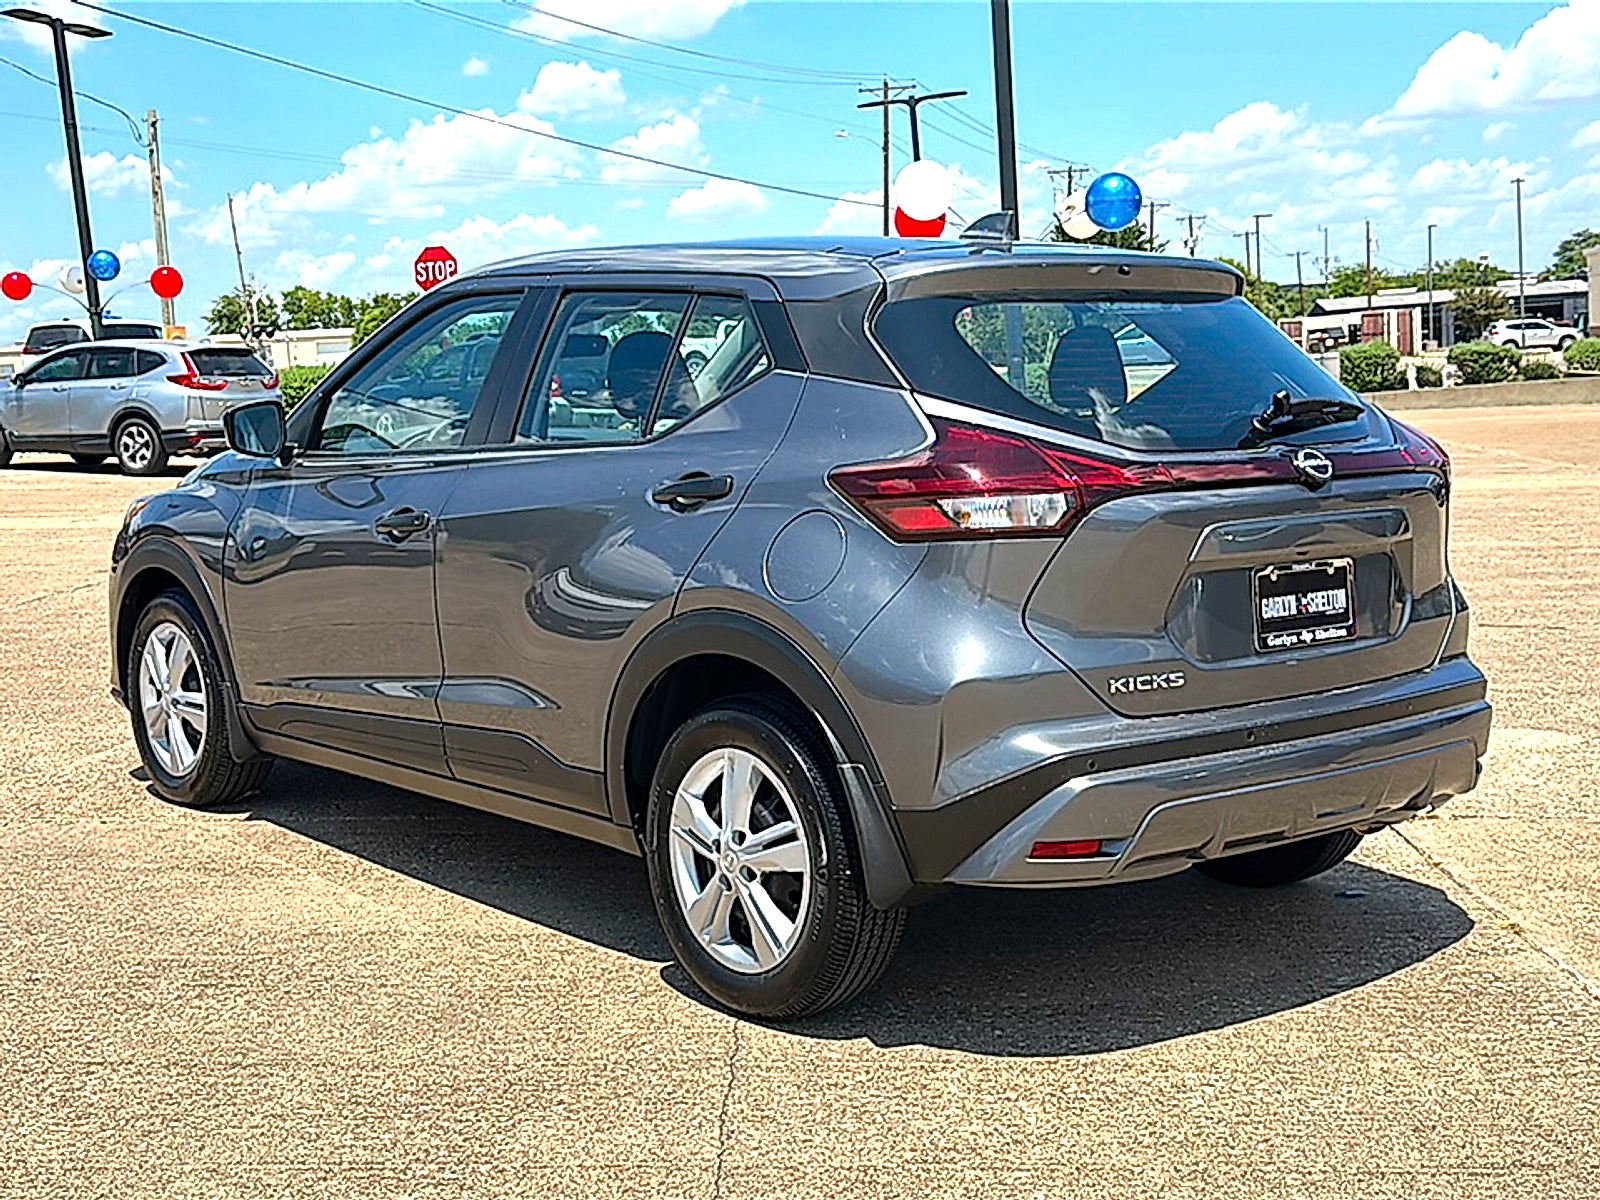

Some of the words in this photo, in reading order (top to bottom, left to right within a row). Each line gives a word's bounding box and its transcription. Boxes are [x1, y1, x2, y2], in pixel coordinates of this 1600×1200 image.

[416, 260, 455, 282] STOP
[1307, 588, 1347, 613] SHELTON
[1109, 672, 1185, 694] KICKS
